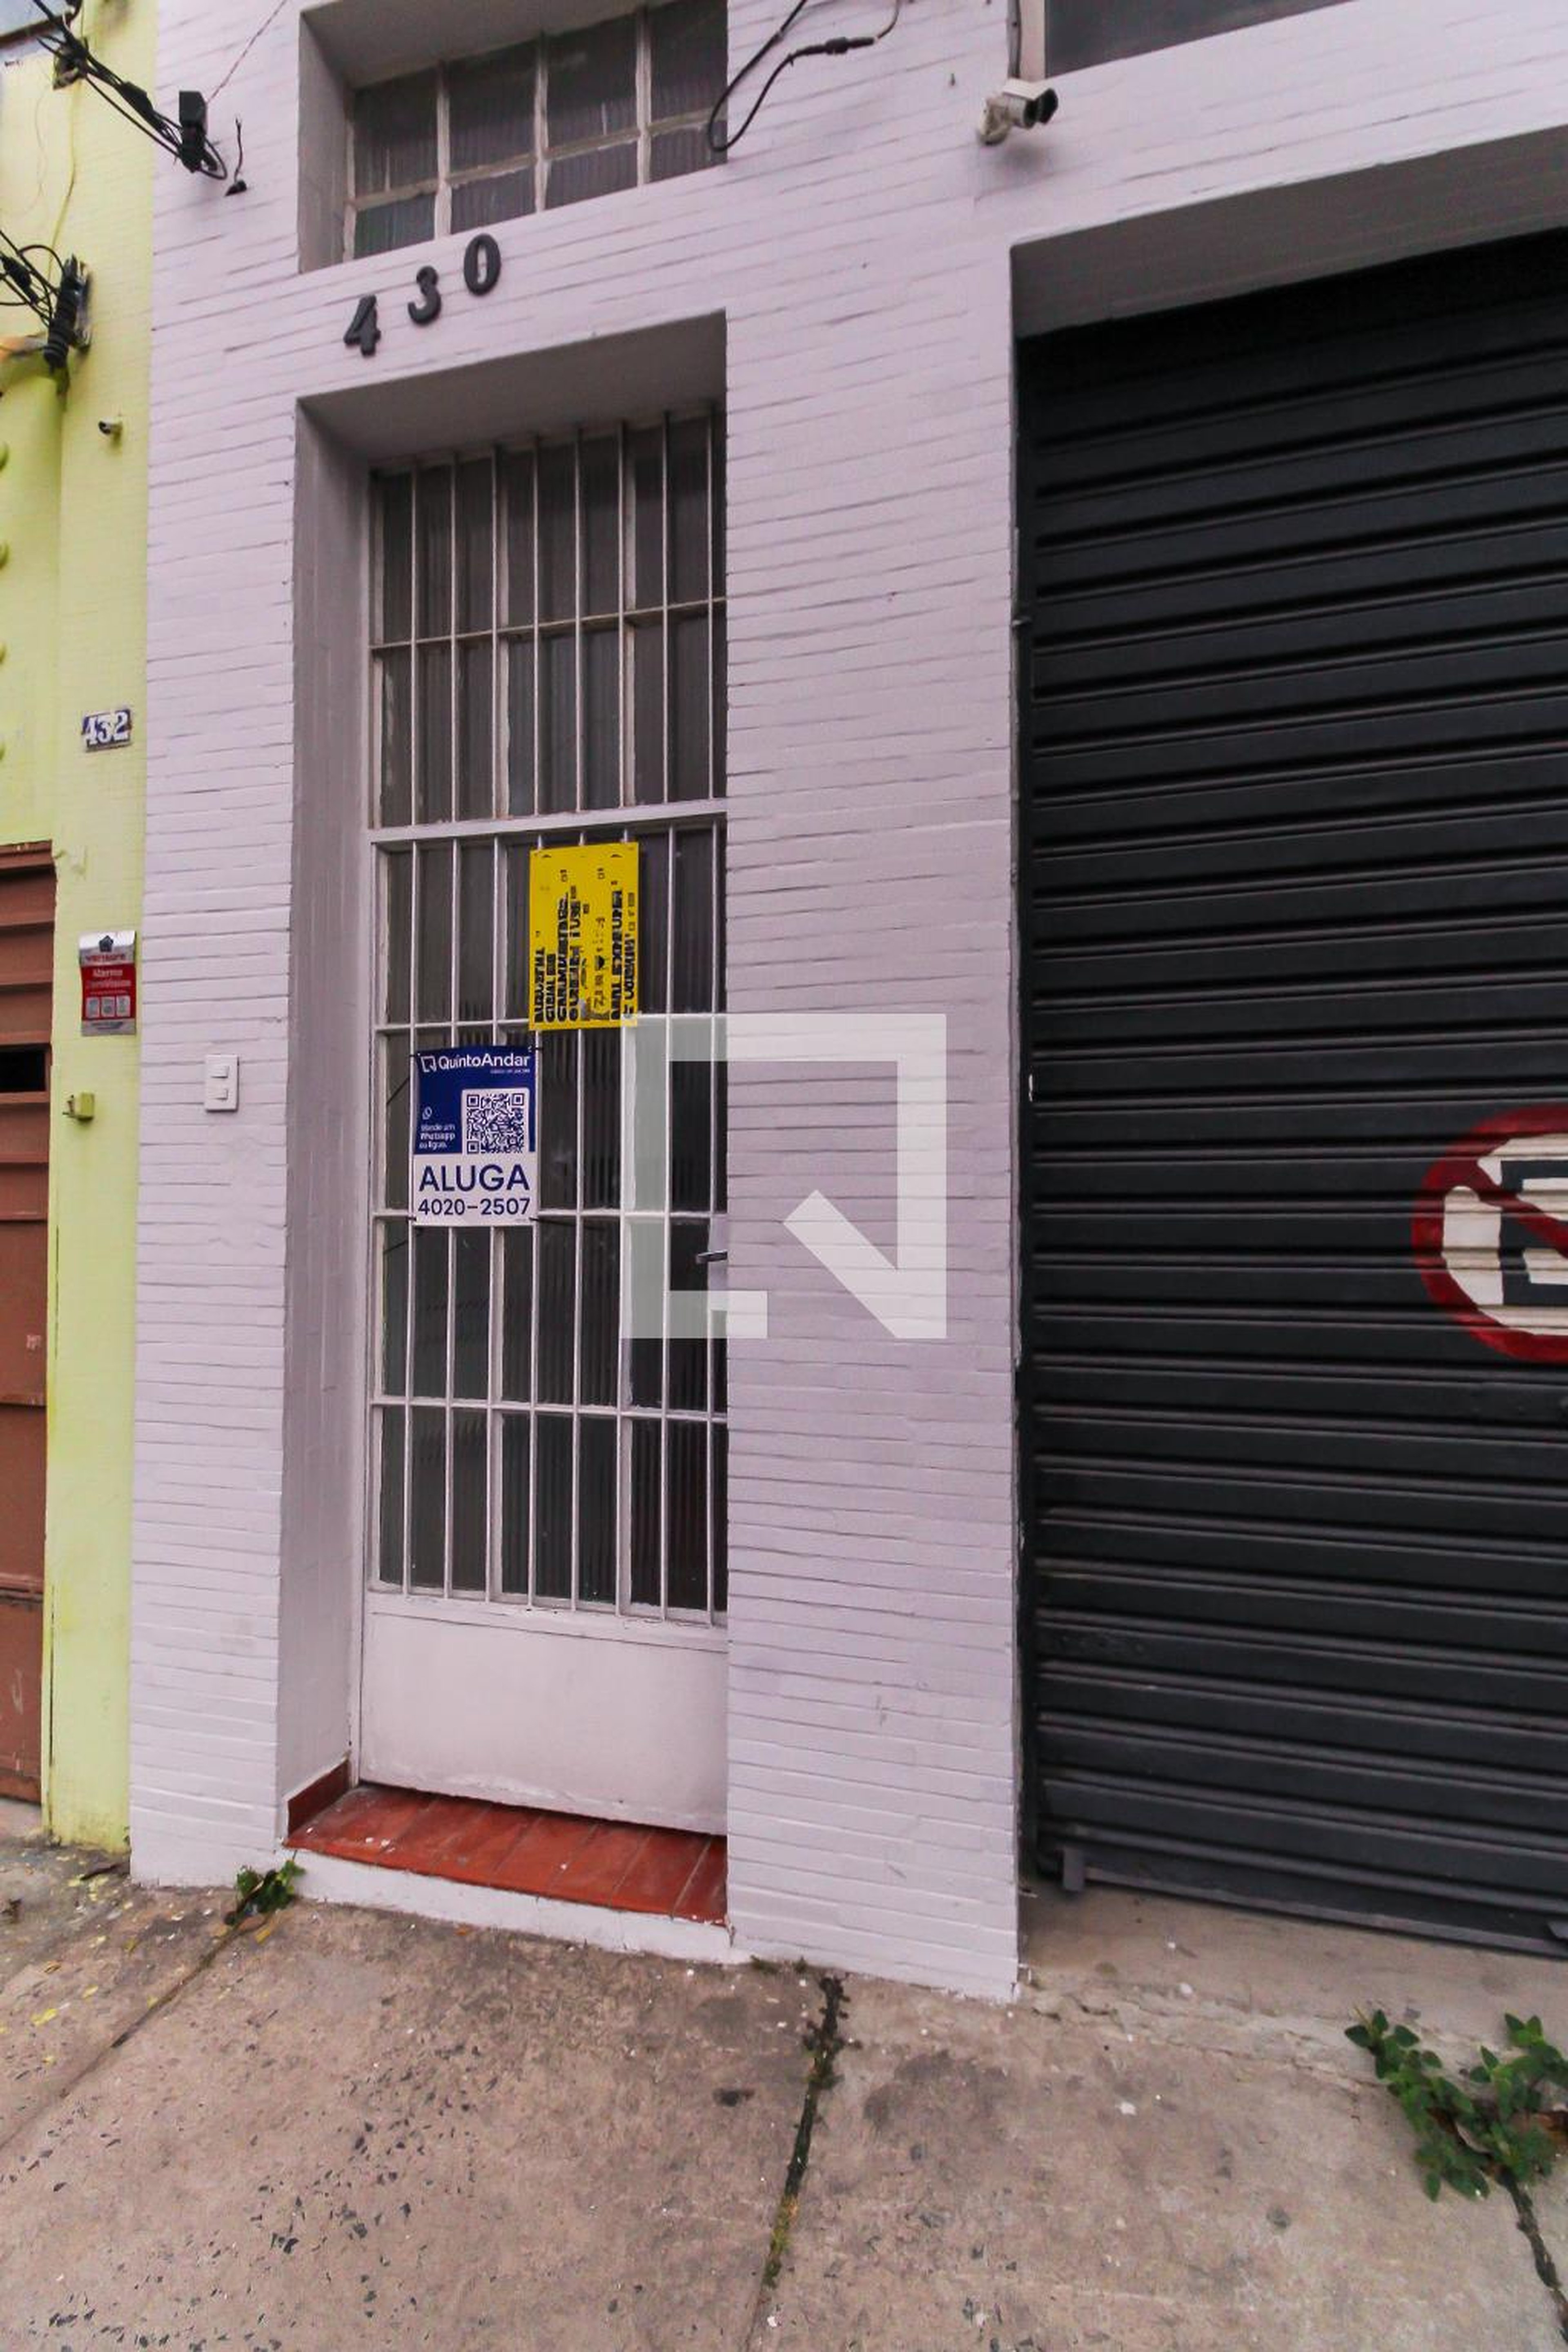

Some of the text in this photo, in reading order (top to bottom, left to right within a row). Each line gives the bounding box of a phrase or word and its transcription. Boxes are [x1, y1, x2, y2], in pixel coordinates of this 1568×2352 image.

[343, 233, 501, 356] 430
[83, 711, 129, 746] 432
[438, 1052, 530, 1070] QuintoAndar
[419, 1164, 530, 1192] ALUGA
[418, 1197, 530, 1216] 4020-2507
